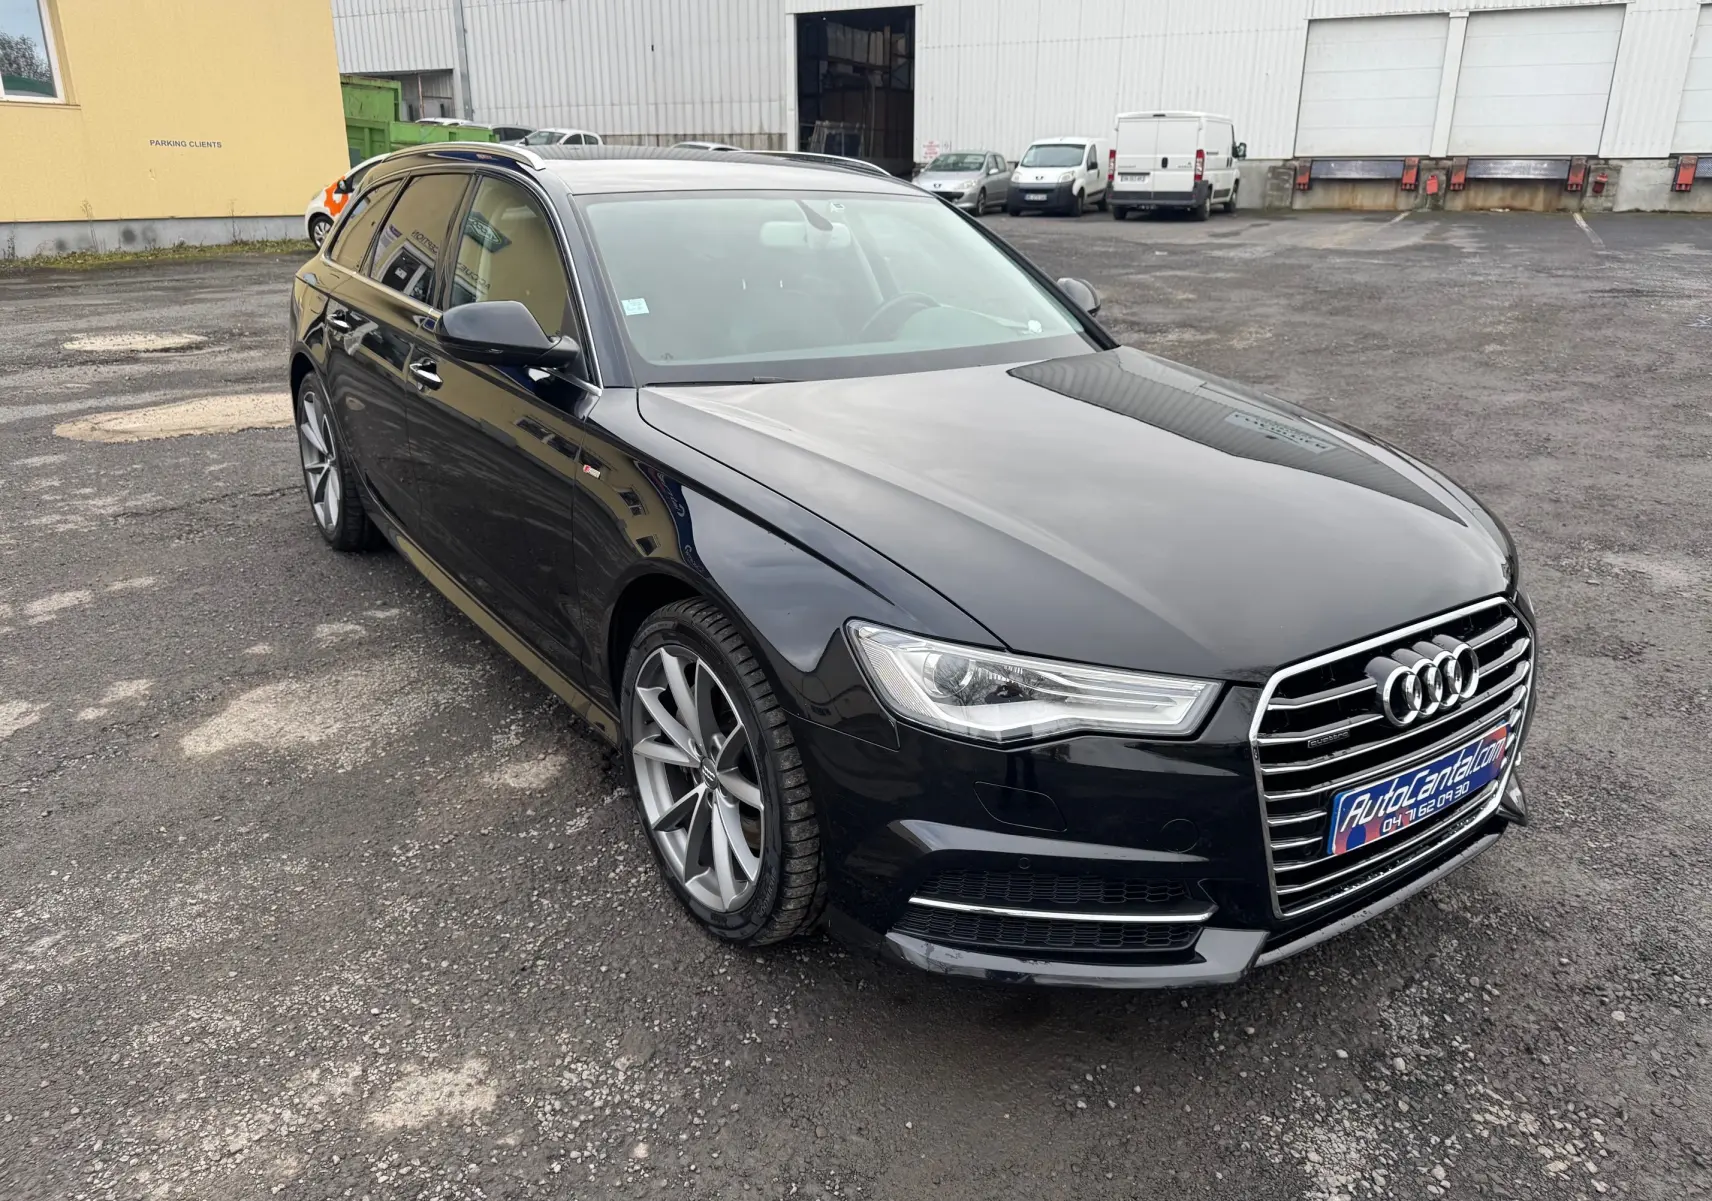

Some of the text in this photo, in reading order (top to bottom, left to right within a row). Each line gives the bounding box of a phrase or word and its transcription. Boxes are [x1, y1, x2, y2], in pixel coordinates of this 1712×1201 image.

[149, 139, 222, 148] PARKING CLIENTS
[1339, 736, 1507, 833] AutoCantal.com
[1382, 780, 1471, 833] 04 71 62 09 30
